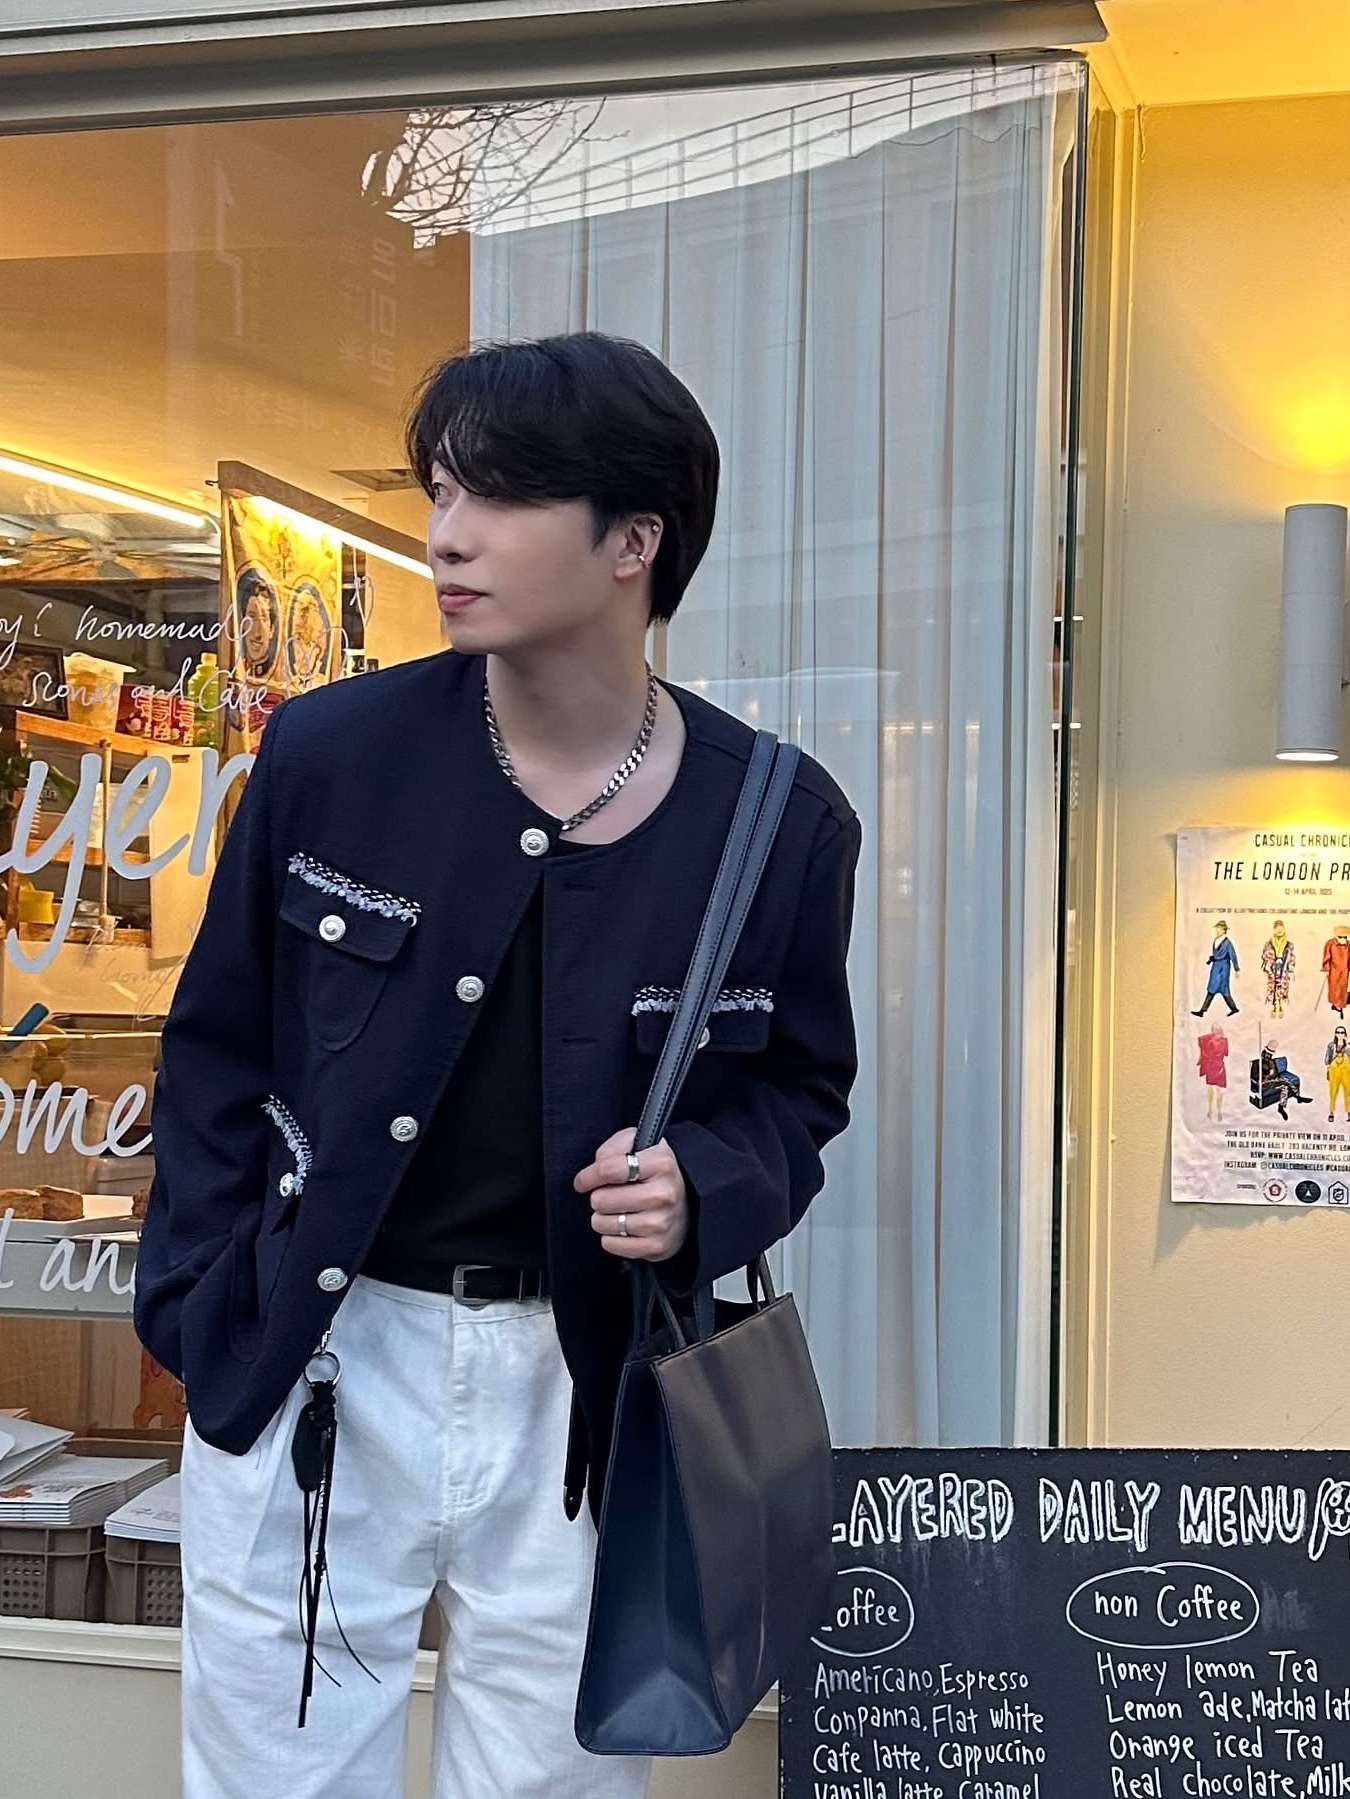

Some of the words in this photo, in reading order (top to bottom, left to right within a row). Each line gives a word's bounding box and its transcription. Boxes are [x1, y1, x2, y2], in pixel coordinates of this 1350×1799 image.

[75, 604, 252, 641] homemade
[0, 748, 256, 973] yer
[1255, 833, 1296, 848] CASUAL
[1300, 834, 1350, 848] CHRONIC
[1214, 861, 1245, 881] THE
[1252, 861, 1322, 881] LONDON
[1329, 862, 1350, 881] PR
[40, 1238, 136, 1295] an
[831, 1472, 1015, 1548] AYERED
[1039, 1477, 1161, 1553] DAILY
[1178, 1484, 1307, 1547] MENU
[821, 1587, 901, 1632] offee
[1157, 1584, 1245, 1628] Coffee
[1096, 1651, 1167, 1697] Honey
[1185, 1654, 1255, 1690] lemon
[1268, 1650, 1319, 1683] Tea
[932, 1703, 979, 1738] Flat
[989, 1698, 1045, 1734] white
[1105, 1693, 1183, 1724] Lemon
[812, 1741, 863, 1774] Cafe
[873, 1738, 930, 1774] latte,
[938, 1739, 1047, 1778] Cappuccino
[1109, 1730, 1197, 1764] Orange
[1212, 1725, 1264, 1759] iced
[1274, 1728, 1324, 1762] Tea
[1111, 1766, 1162, 1799] Real
